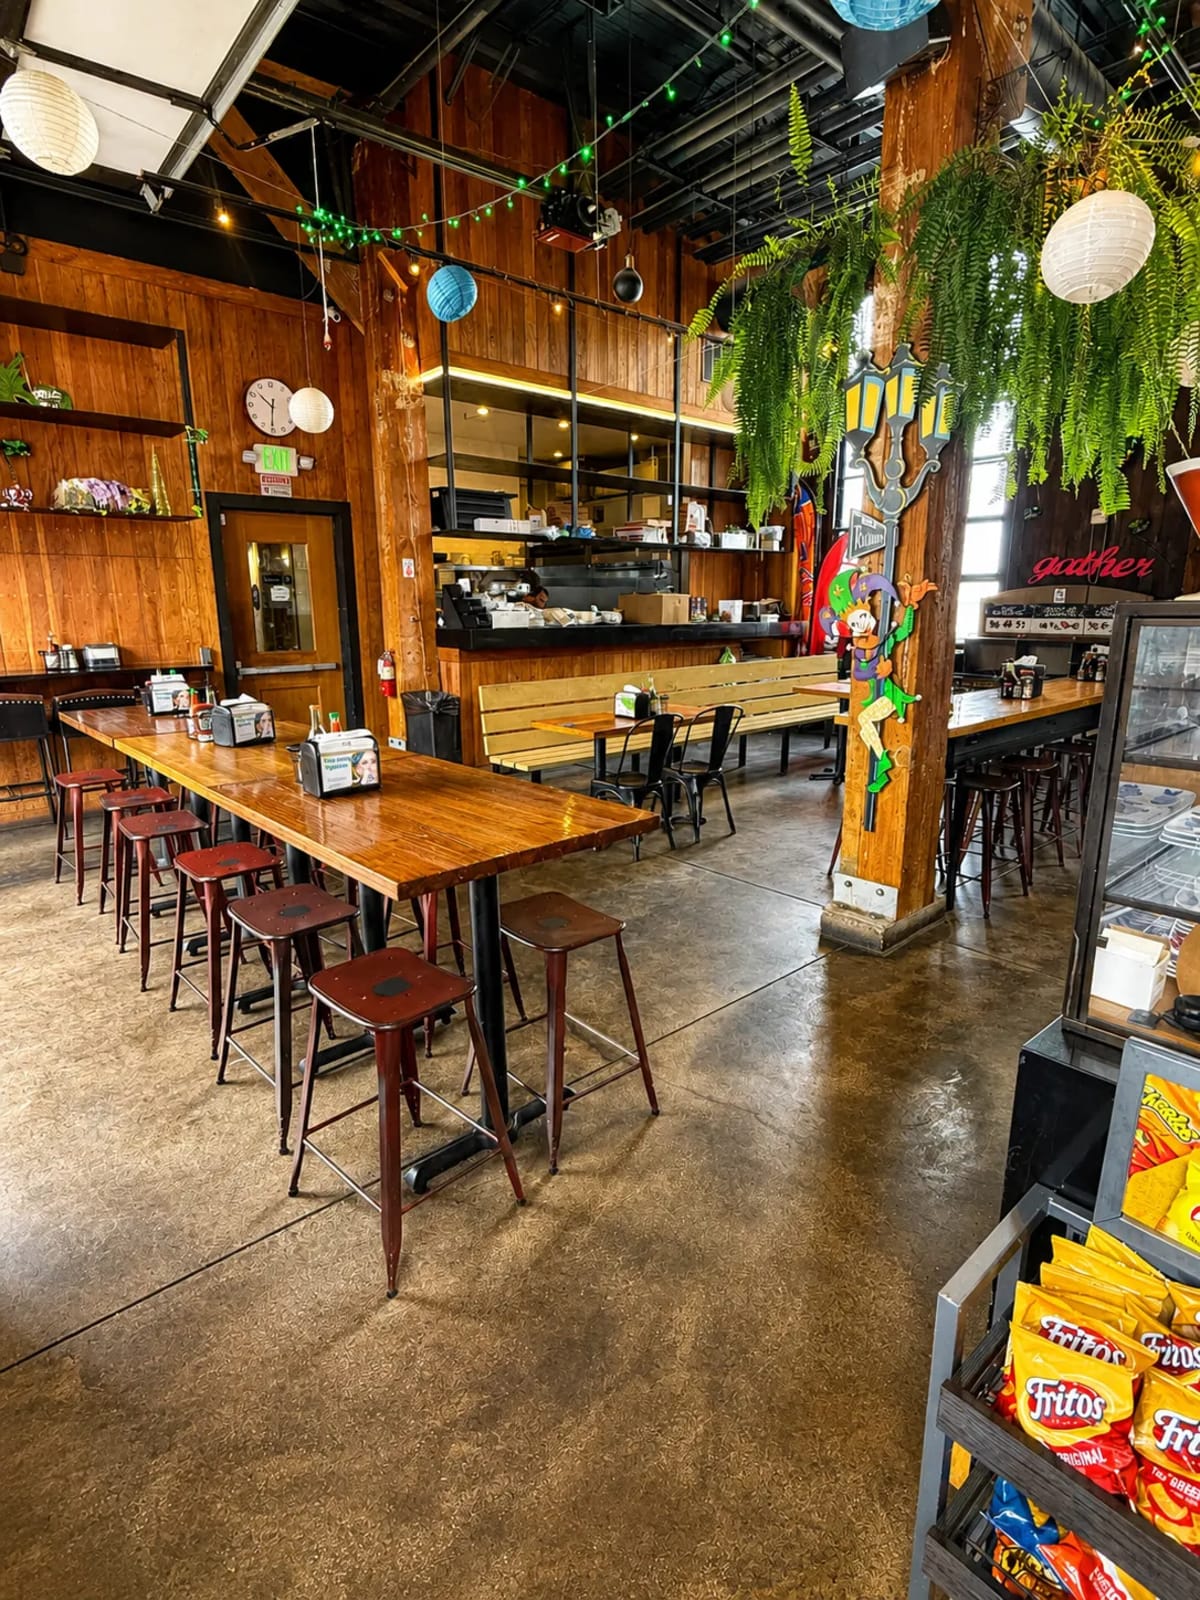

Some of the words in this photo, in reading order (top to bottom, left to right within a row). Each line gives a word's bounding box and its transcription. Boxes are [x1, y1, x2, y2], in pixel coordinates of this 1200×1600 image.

[262, 446, 291, 471] EXIT
[1027, 545, 1156, 585] gather
[1040, 1315, 1126, 1367] Fritos
[1025, 1377, 1106, 1420] Fritos
